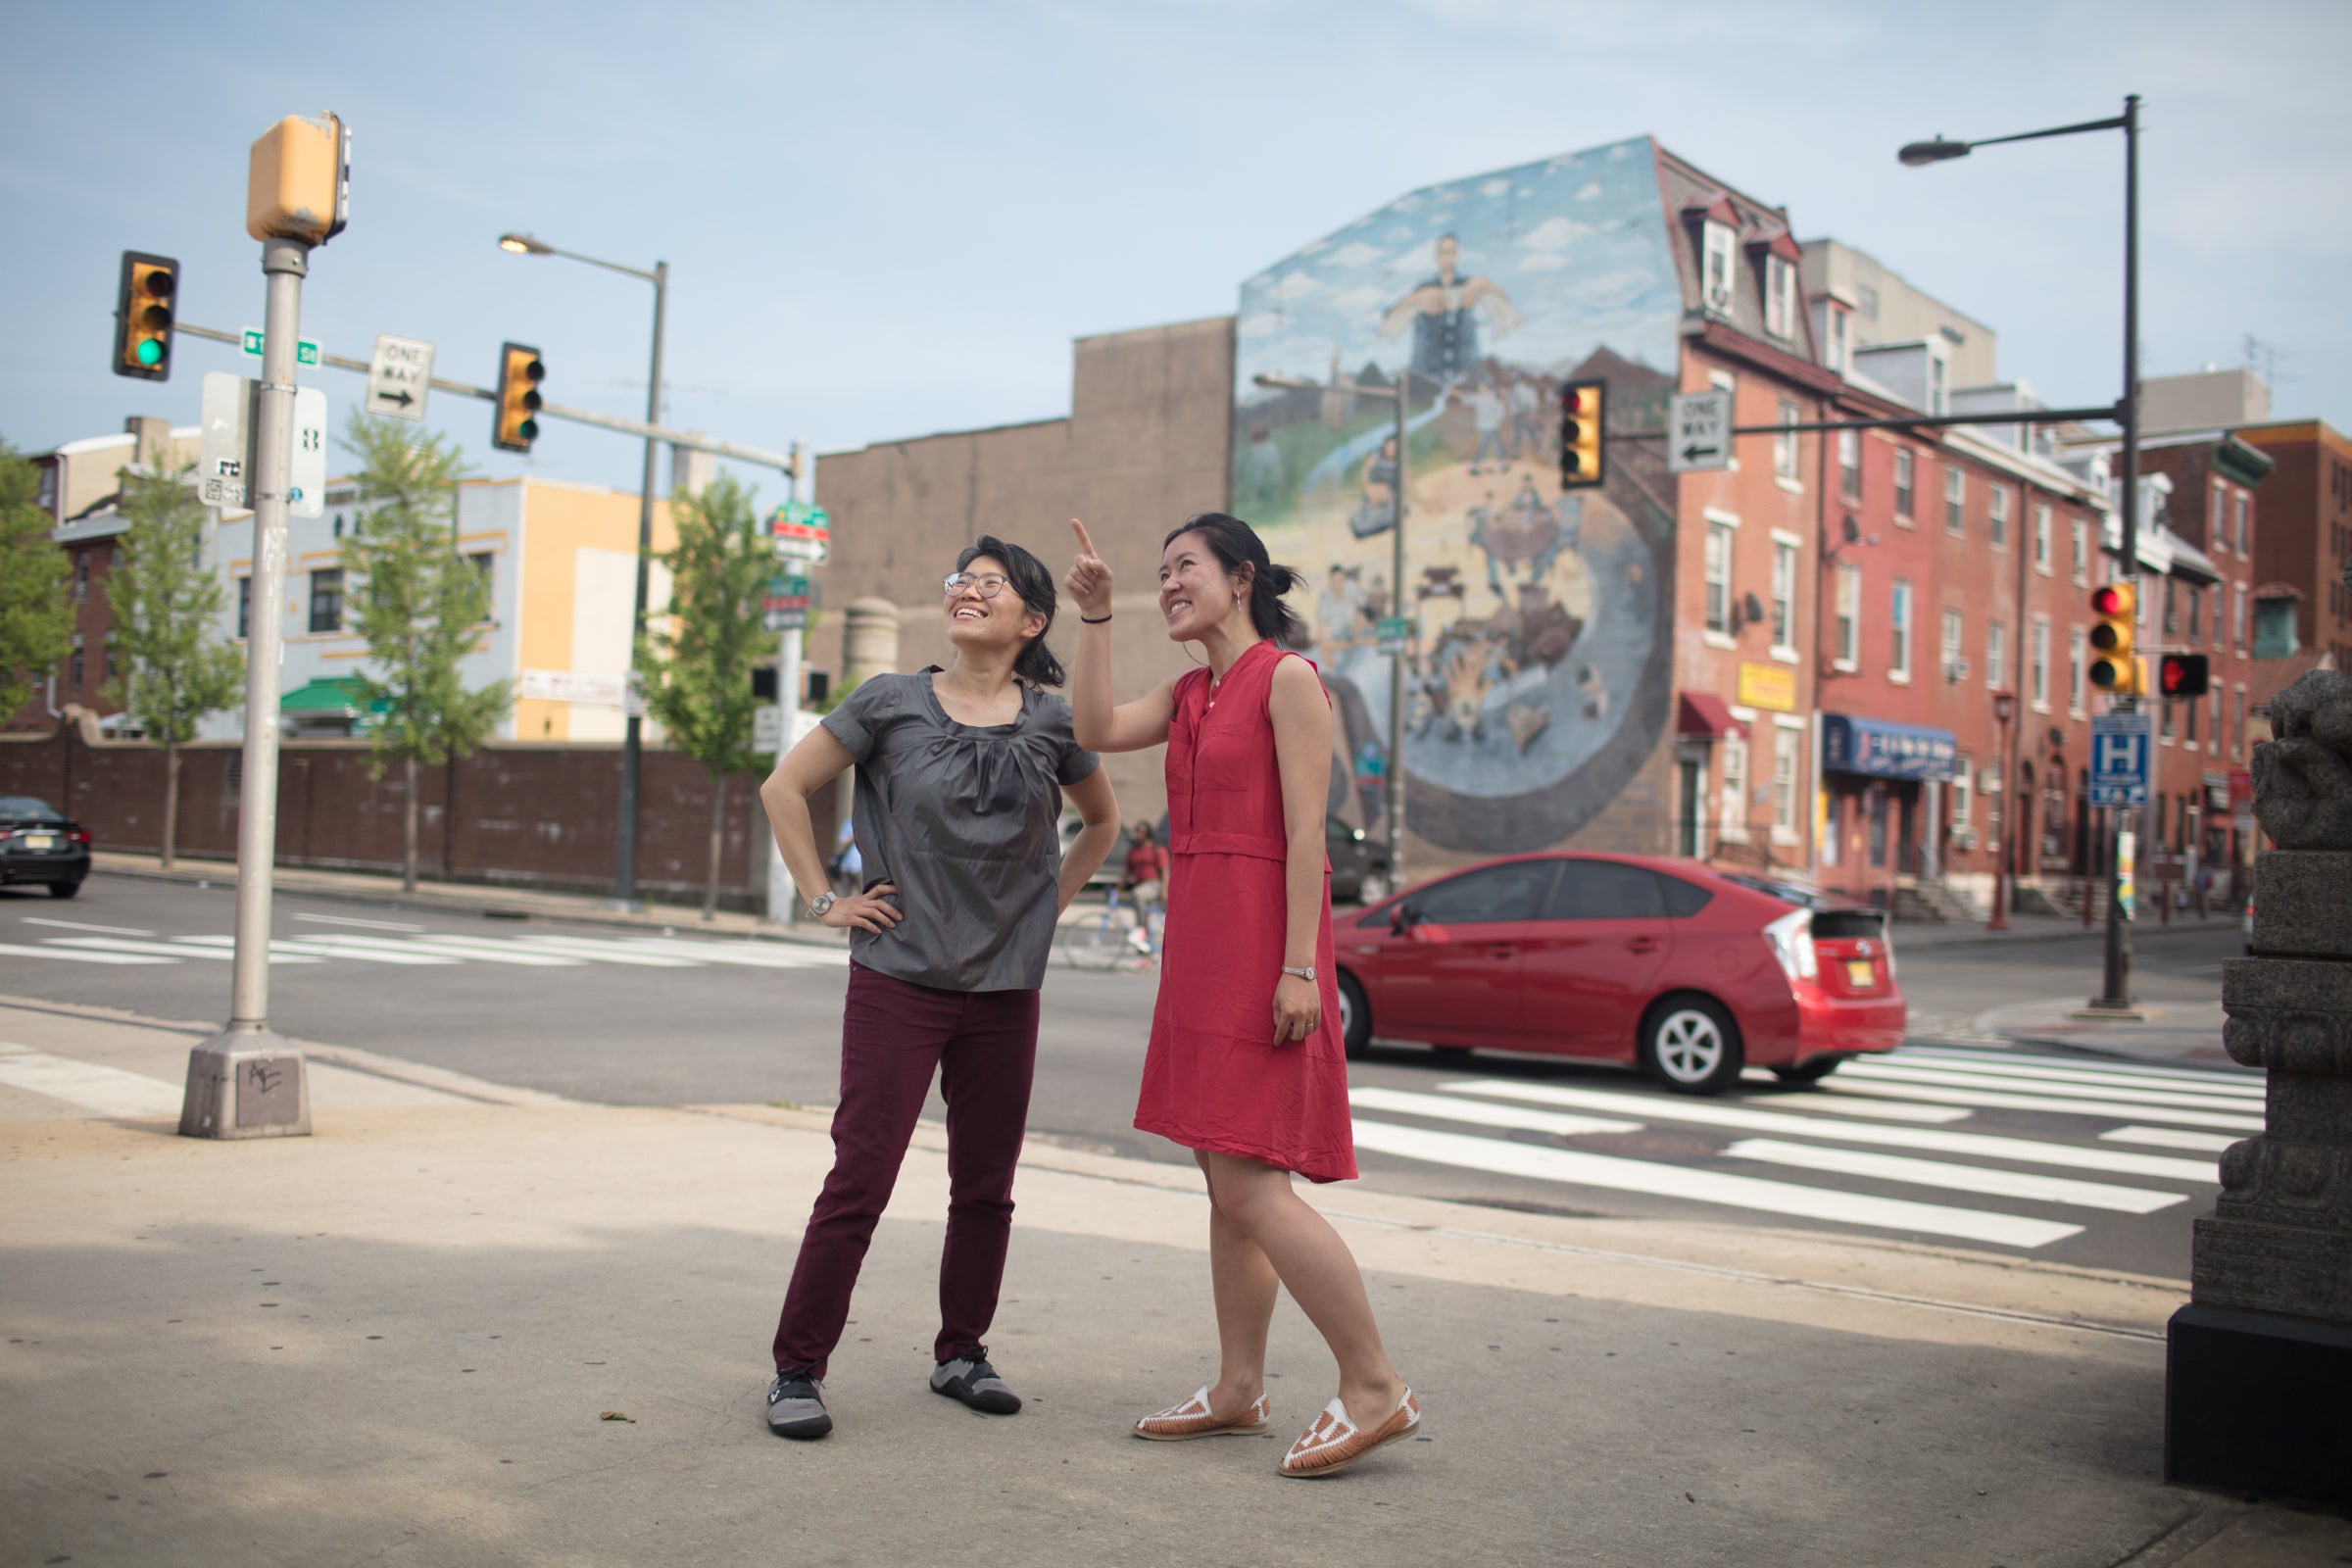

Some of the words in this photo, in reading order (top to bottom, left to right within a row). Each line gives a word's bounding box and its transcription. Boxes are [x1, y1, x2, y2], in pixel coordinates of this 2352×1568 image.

[386, 344, 423, 367] ONE
[383, 365, 420, 384] WAY
[1683, 397, 1721, 417] ONE
[1681, 418, 1722, 438] WAY
[2101, 735, 2138, 772] H
